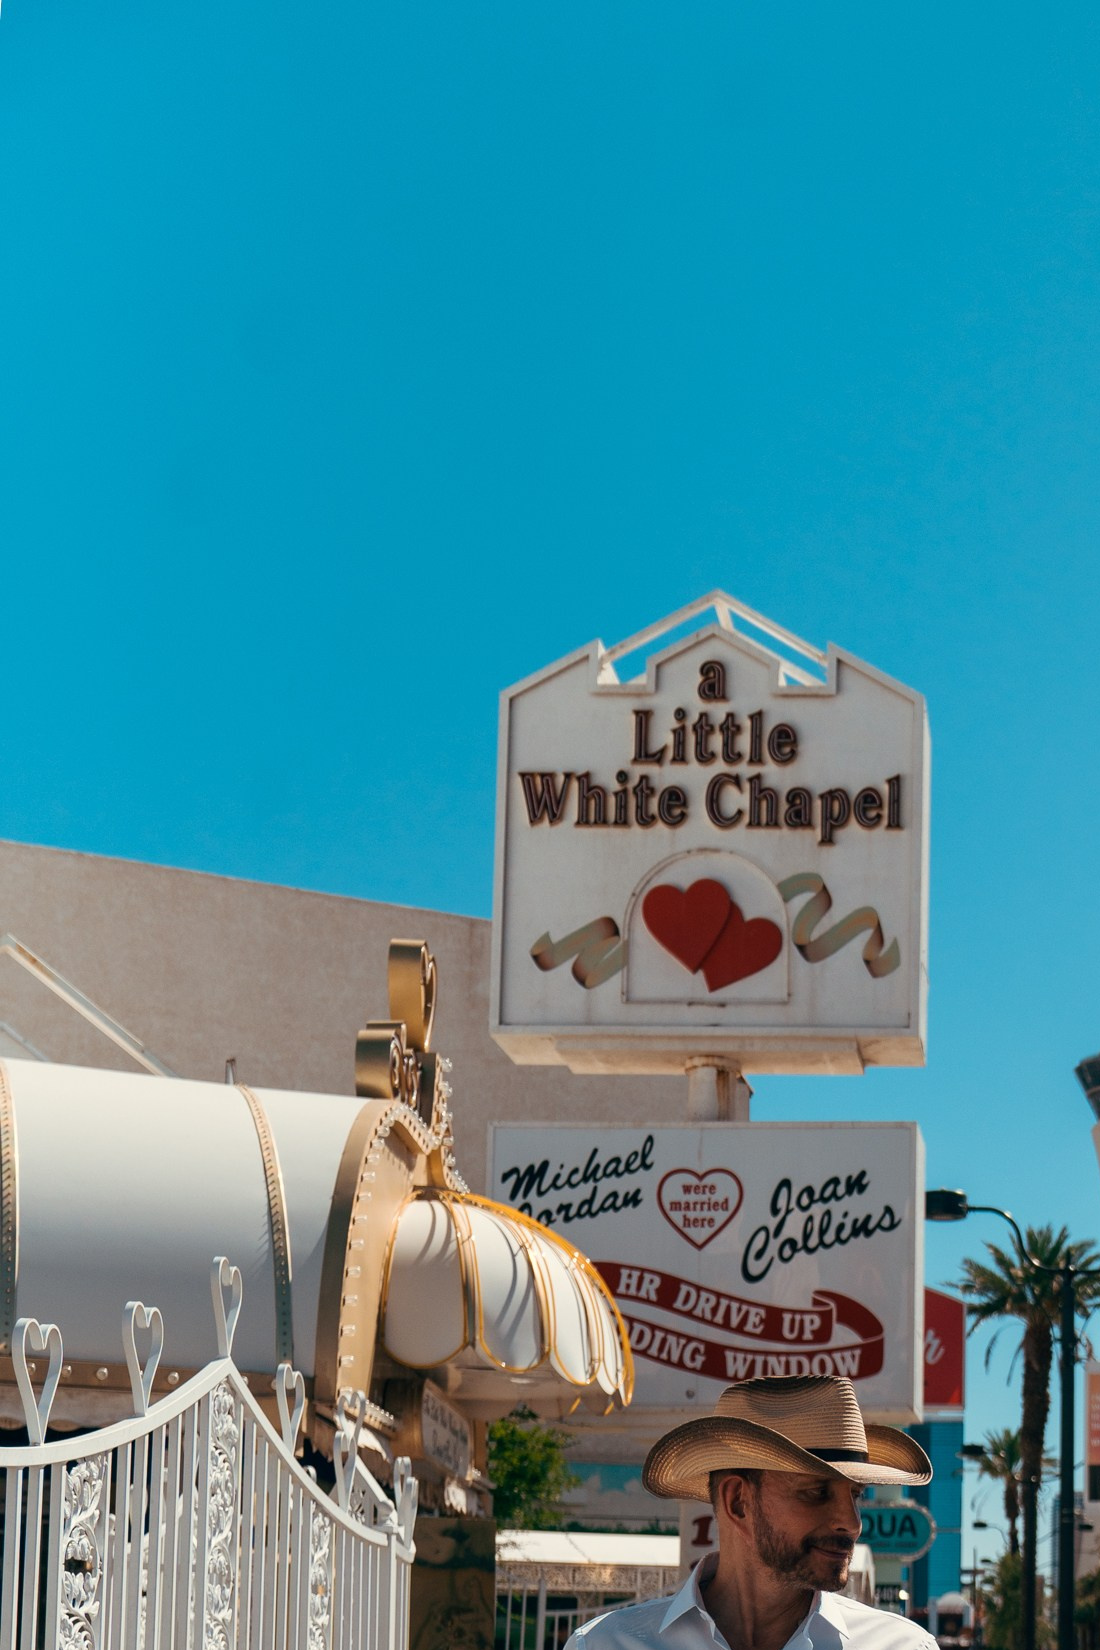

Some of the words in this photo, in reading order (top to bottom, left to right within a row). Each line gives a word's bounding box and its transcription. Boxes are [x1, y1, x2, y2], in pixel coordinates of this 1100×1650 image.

[697, 658, 729, 702] a
[630, 706, 798, 766] Little
[517, 769, 689, 828] White
[704, 771, 905, 846] Chapel
[501, 1134, 655, 1202] Michael
[682, 1183, 717, 1196] were
[669, 1197, 730, 1213] married
[682, 1214, 716, 1229] here
[770, 1169, 871, 1240] Joan
[741, 1205, 902, 1284] Collins
[616, 1267, 661, 1302] HR
[672, 1283, 767, 1335] DRIVE
[782, 1312, 822, 1341] UP
[626, 1319, 706, 1371] DING
[724, 1347, 862, 1380] WINDOW
[860, 1512, 917, 1540] QUA
